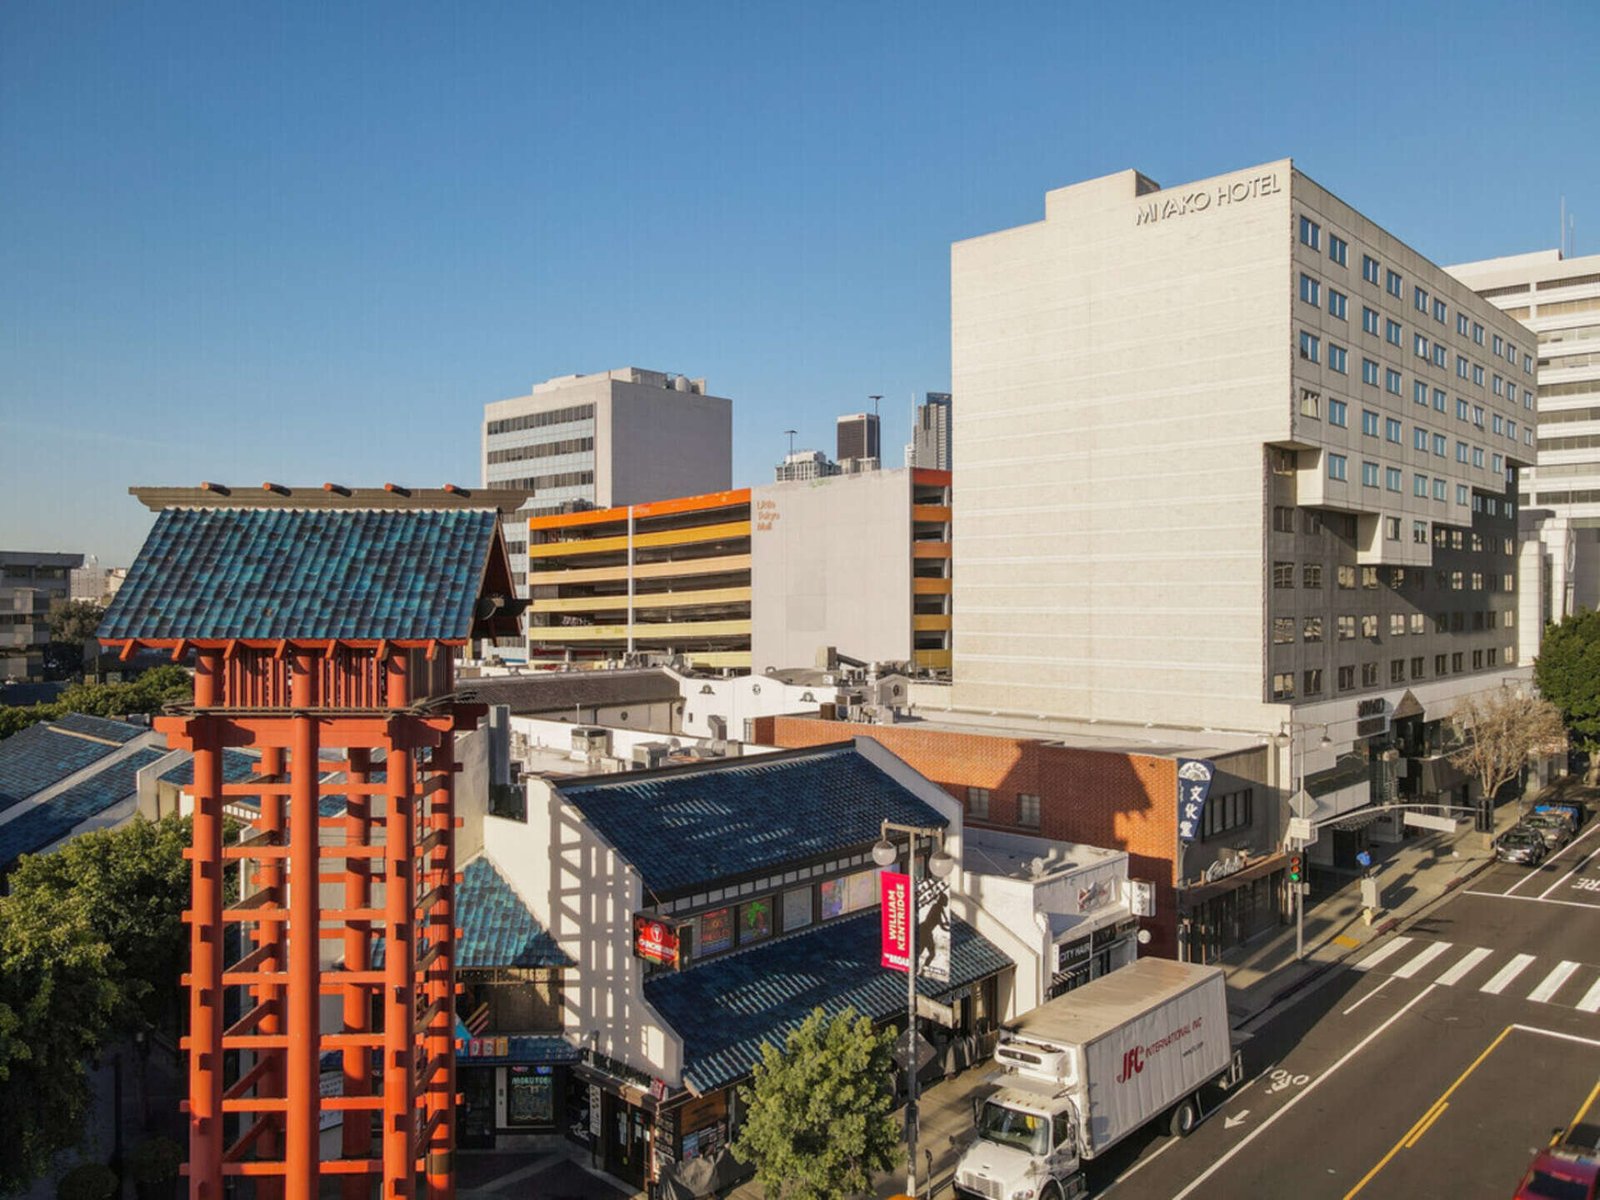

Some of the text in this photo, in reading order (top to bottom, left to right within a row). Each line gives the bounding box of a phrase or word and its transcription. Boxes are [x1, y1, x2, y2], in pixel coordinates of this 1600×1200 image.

[1136, 173, 1282, 226] MIYAKO HOTEL
[888, 890, 897, 940] WILLIAM
[896, 884, 905, 951] KENTRIDGE
[1116, 1045, 1144, 1083] JFC
[1145, 1026, 1190, 1058] INTERNATIONAL
